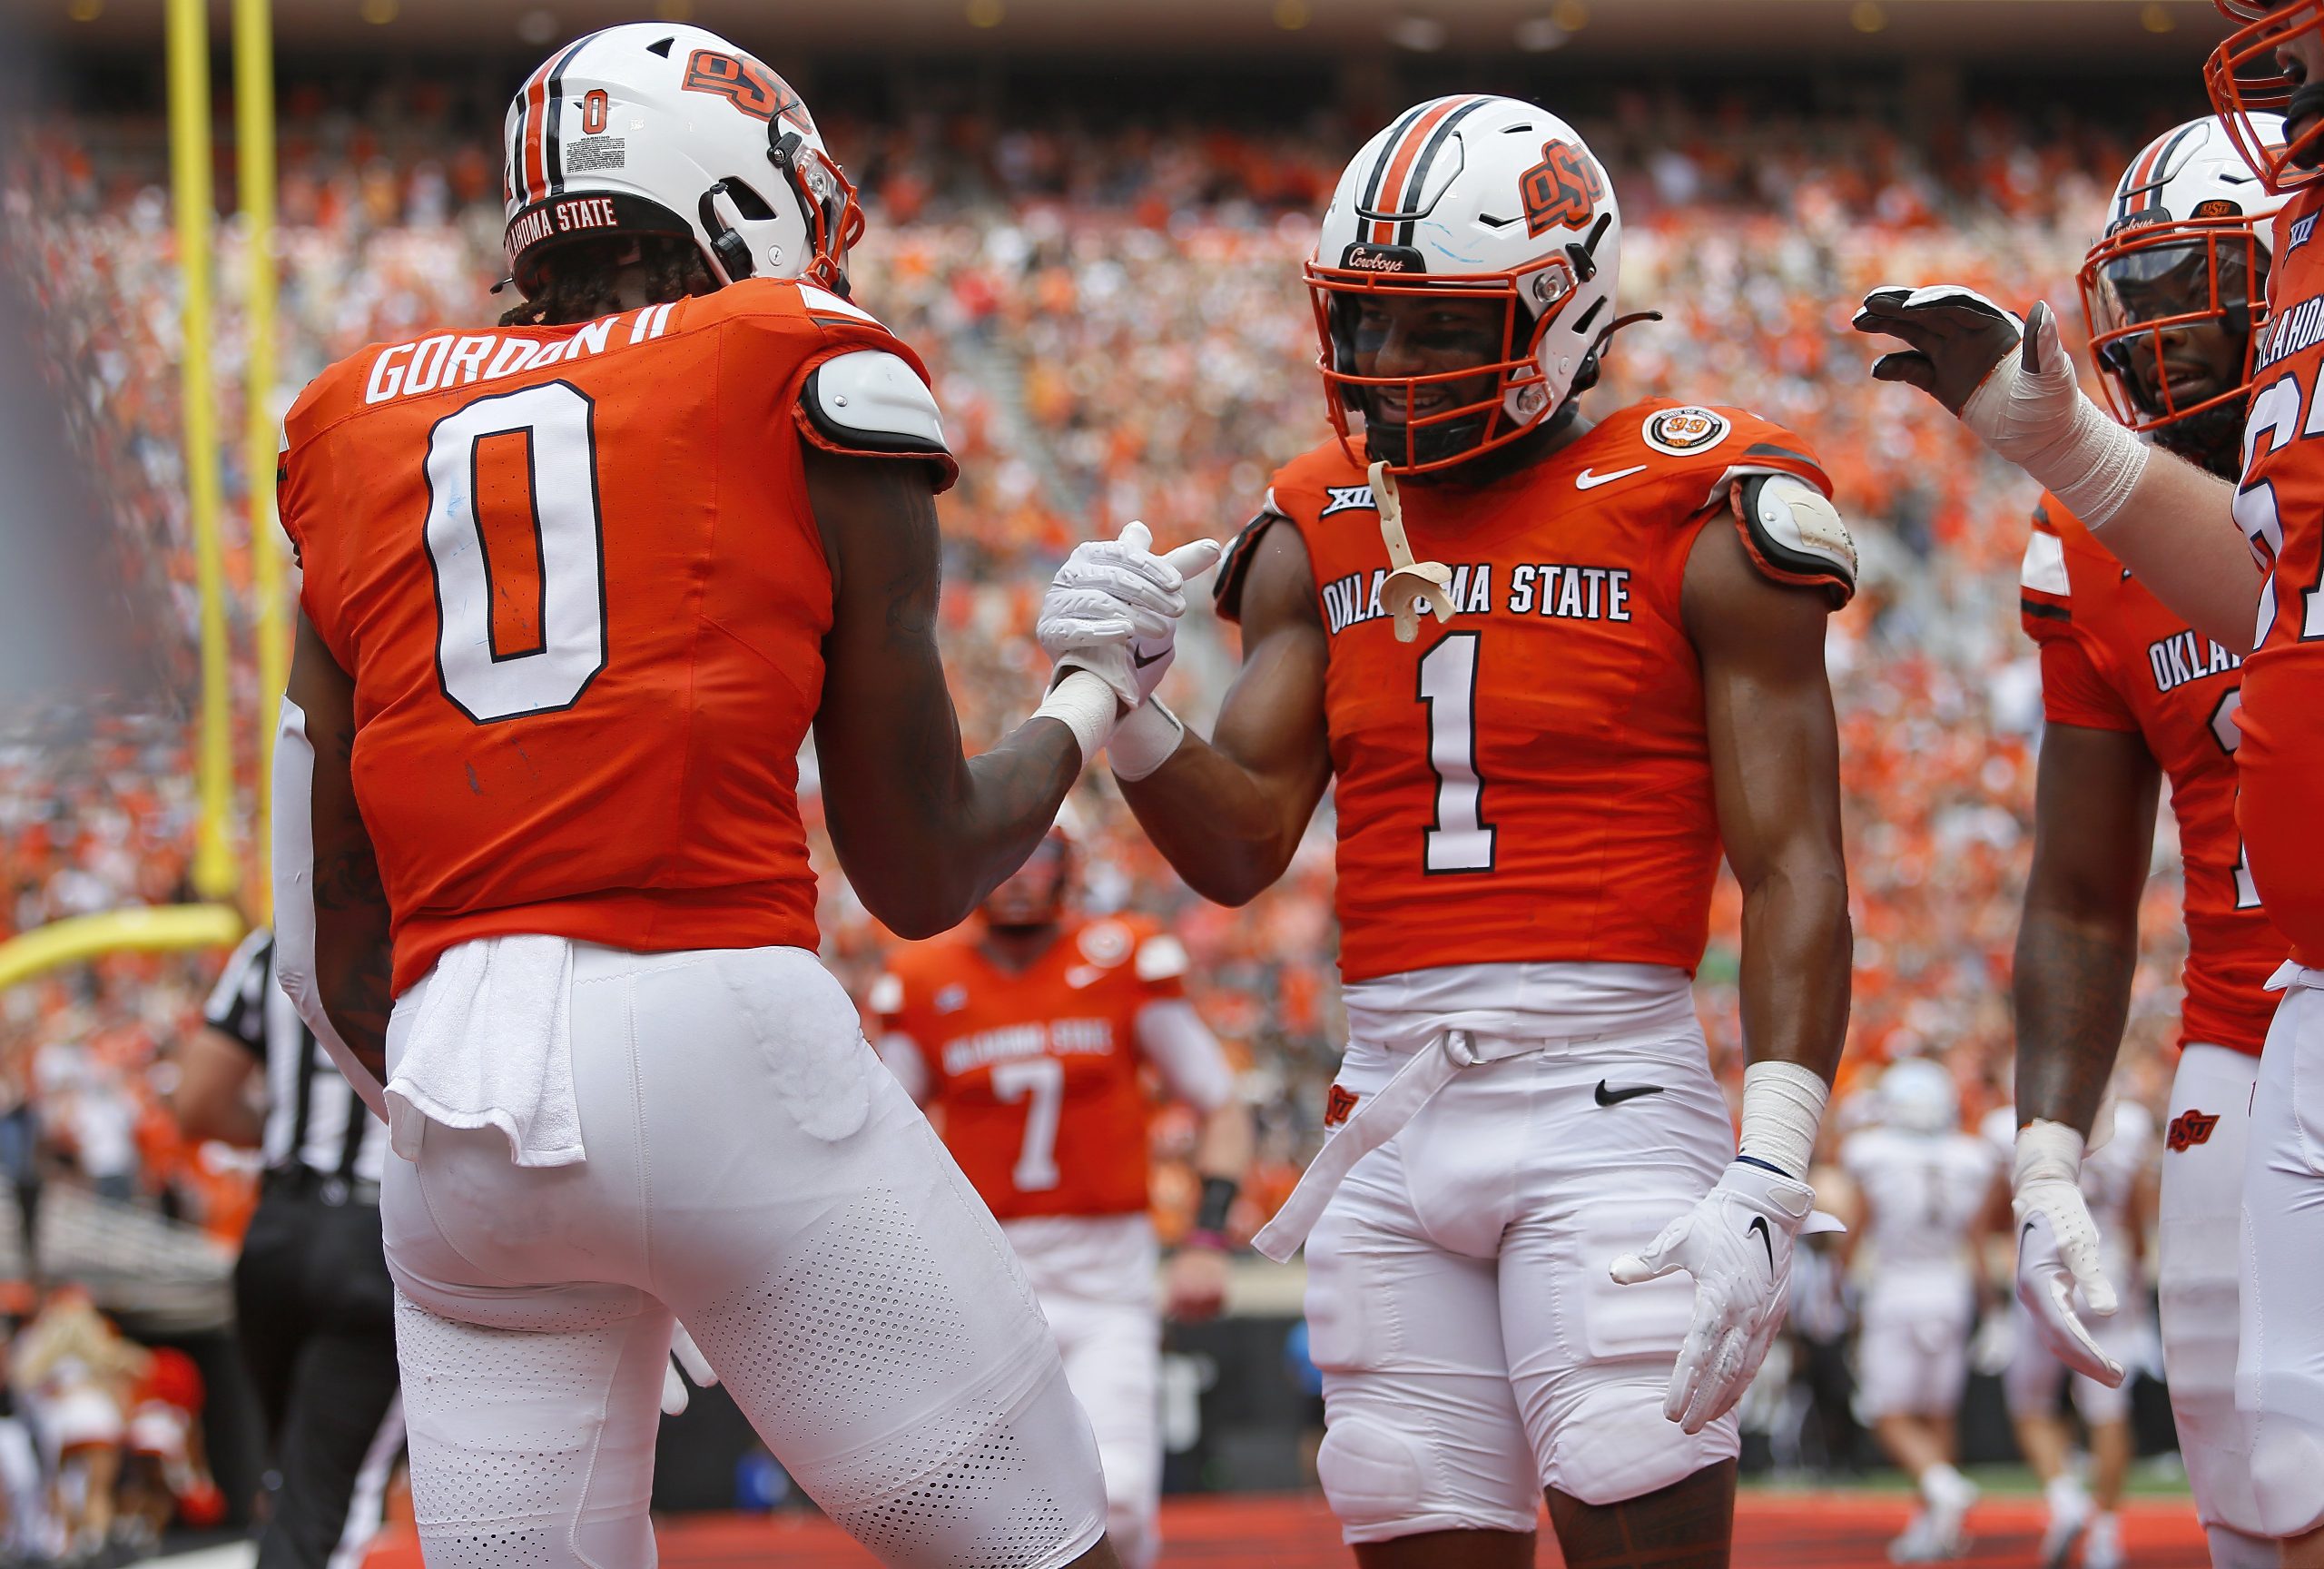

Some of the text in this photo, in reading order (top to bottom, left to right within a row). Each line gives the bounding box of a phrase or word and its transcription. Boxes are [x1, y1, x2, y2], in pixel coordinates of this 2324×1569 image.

[582, 89, 608, 134] 0
[556, 198, 617, 232] STATE
[1349, 247, 1405, 272] Cowboys
[365, 302, 677, 405] GORDON II
[1667, 417, 1708, 433] 99
[422, 379, 609, 725] 0
[1509, 564, 1631, 622] STATE
[1417, 630, 1496, 874] 1
[990, 1058, 1065, 1193] 7
